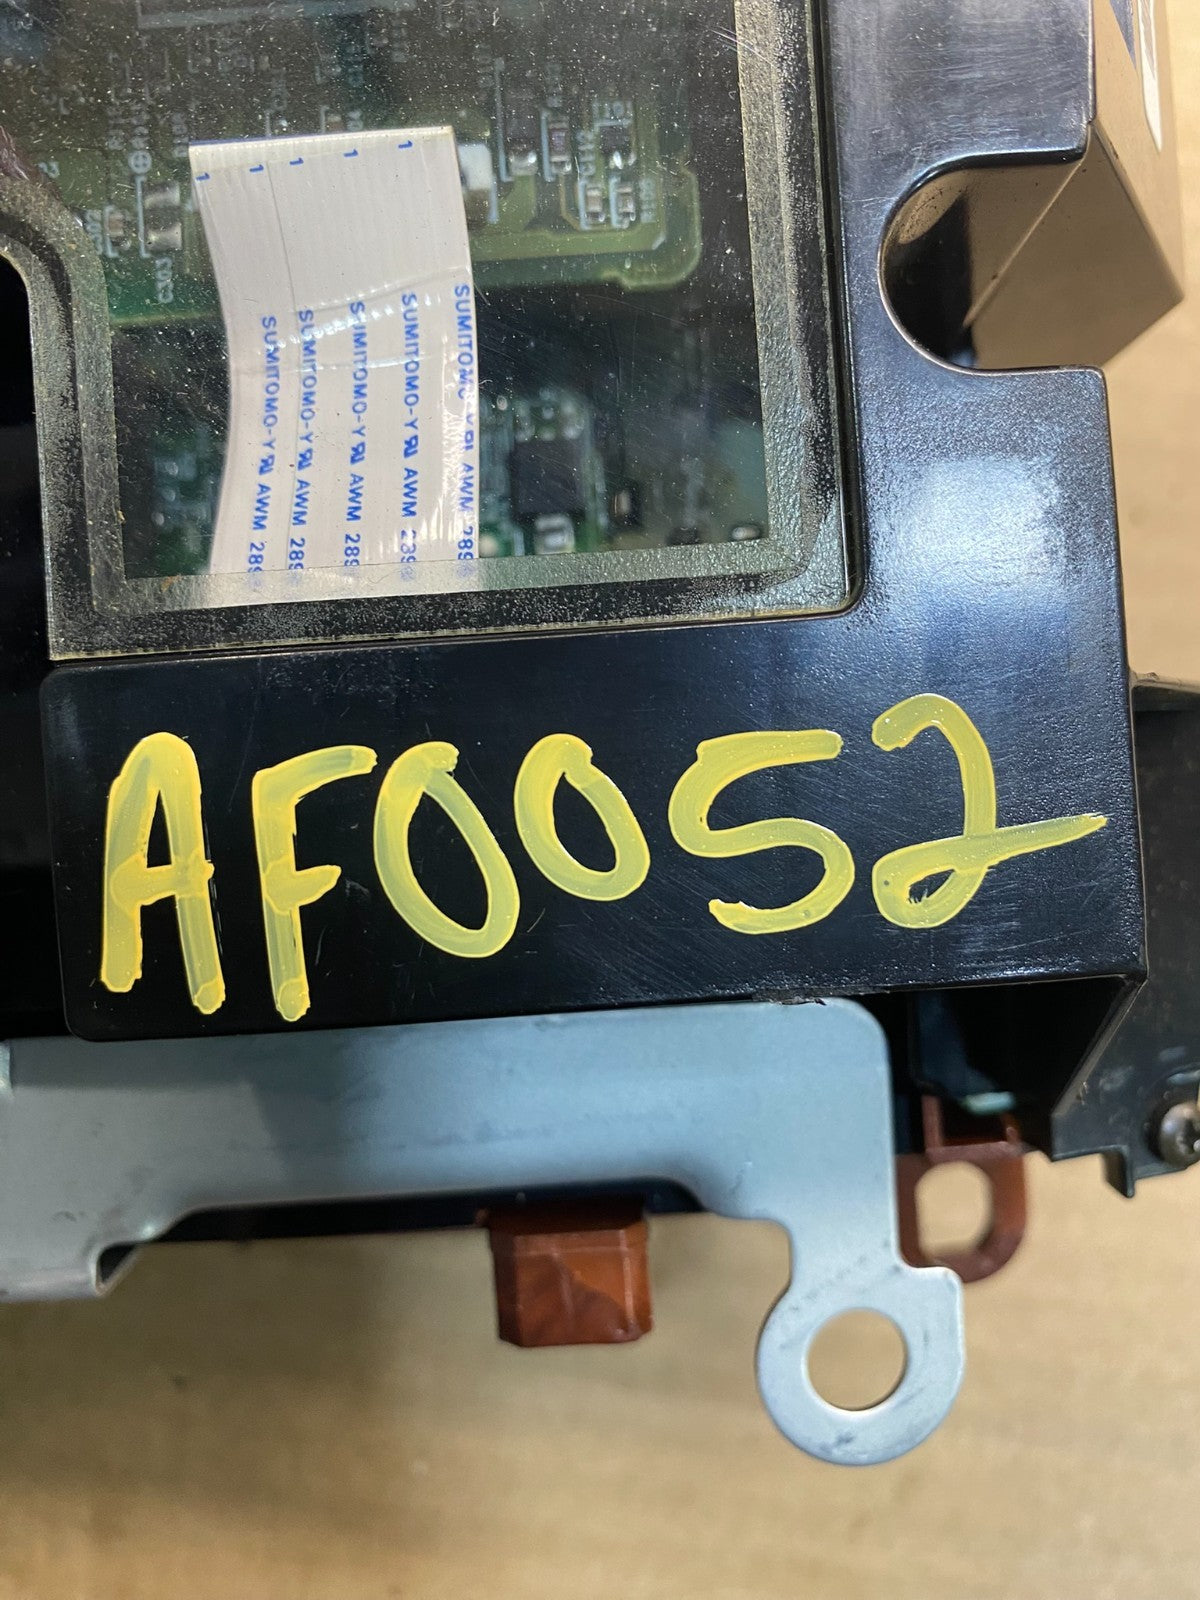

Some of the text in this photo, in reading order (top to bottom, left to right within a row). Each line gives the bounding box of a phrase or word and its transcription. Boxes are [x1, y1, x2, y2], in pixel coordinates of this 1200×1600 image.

[290, 157, 304, 166] 1
[343, 149, 358, 158] 1
[398, 140, 413, 150] 1
[196, 173, 210, 182] 1
[249, 164, 264, 174] 1
[261, 316, 280, 448] SUMITOMO-Y
[401, 293, 420, 430] SUMITOMO-Y
[253, 483, 271, 531] AWM
[292, 479, 310, 526] AWM
[346, 473, 364, 522] AWM
[402, 467, 418, 518] AWM
